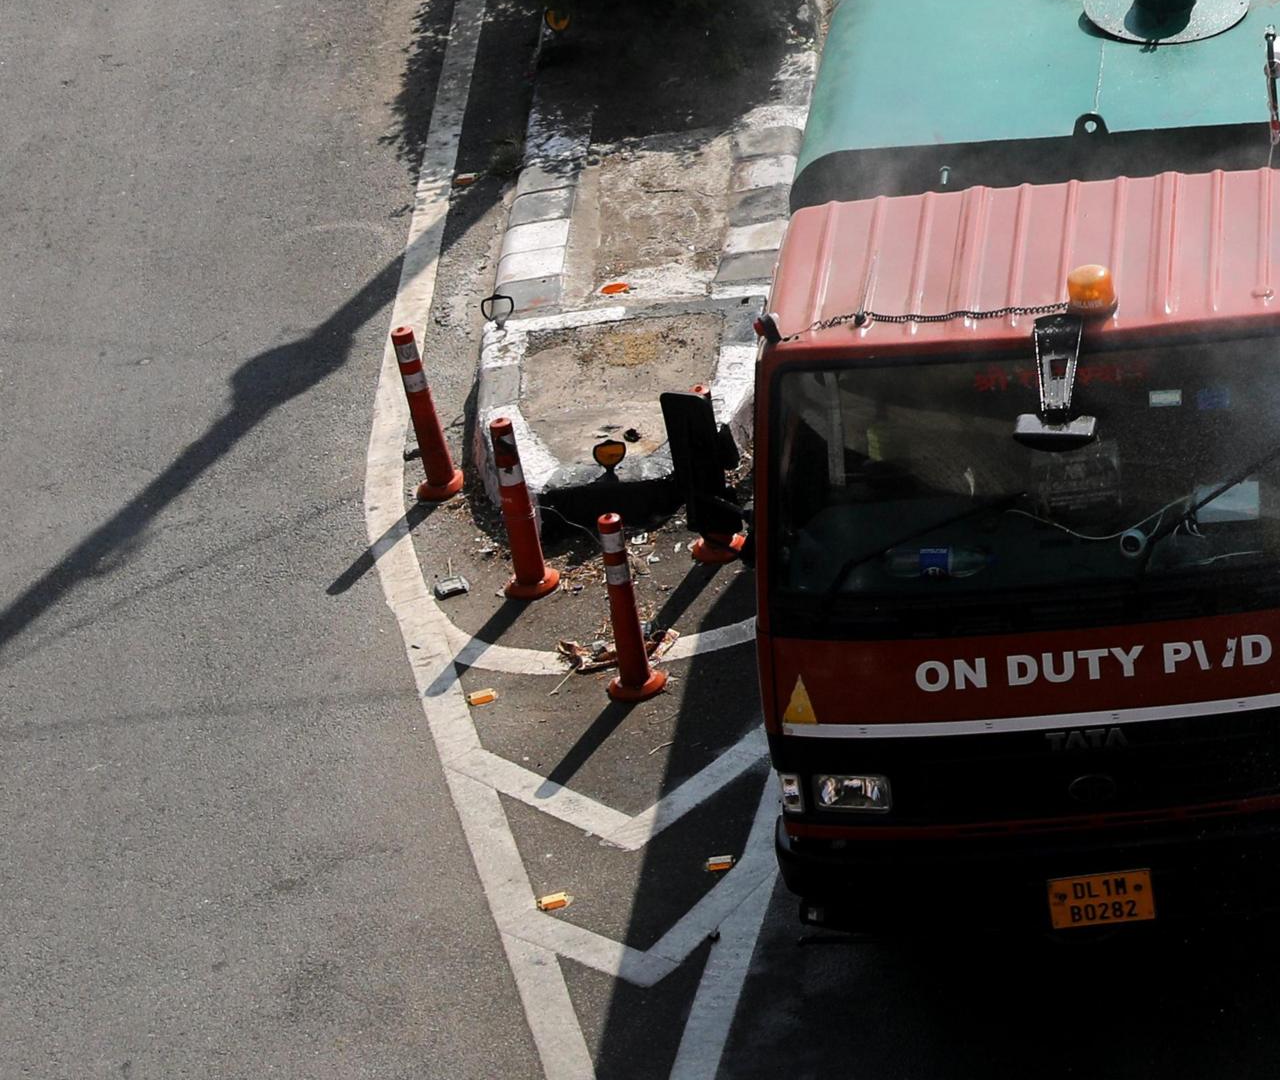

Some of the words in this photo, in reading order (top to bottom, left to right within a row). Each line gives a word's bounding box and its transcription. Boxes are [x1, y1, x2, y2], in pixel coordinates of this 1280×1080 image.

[914, 658, 988, 693] ON
[1006, 643, 1145, 687] DUTY
[1044, 726, 1129, 753] TATA
[1070, 900, 1138, 923] B0282
